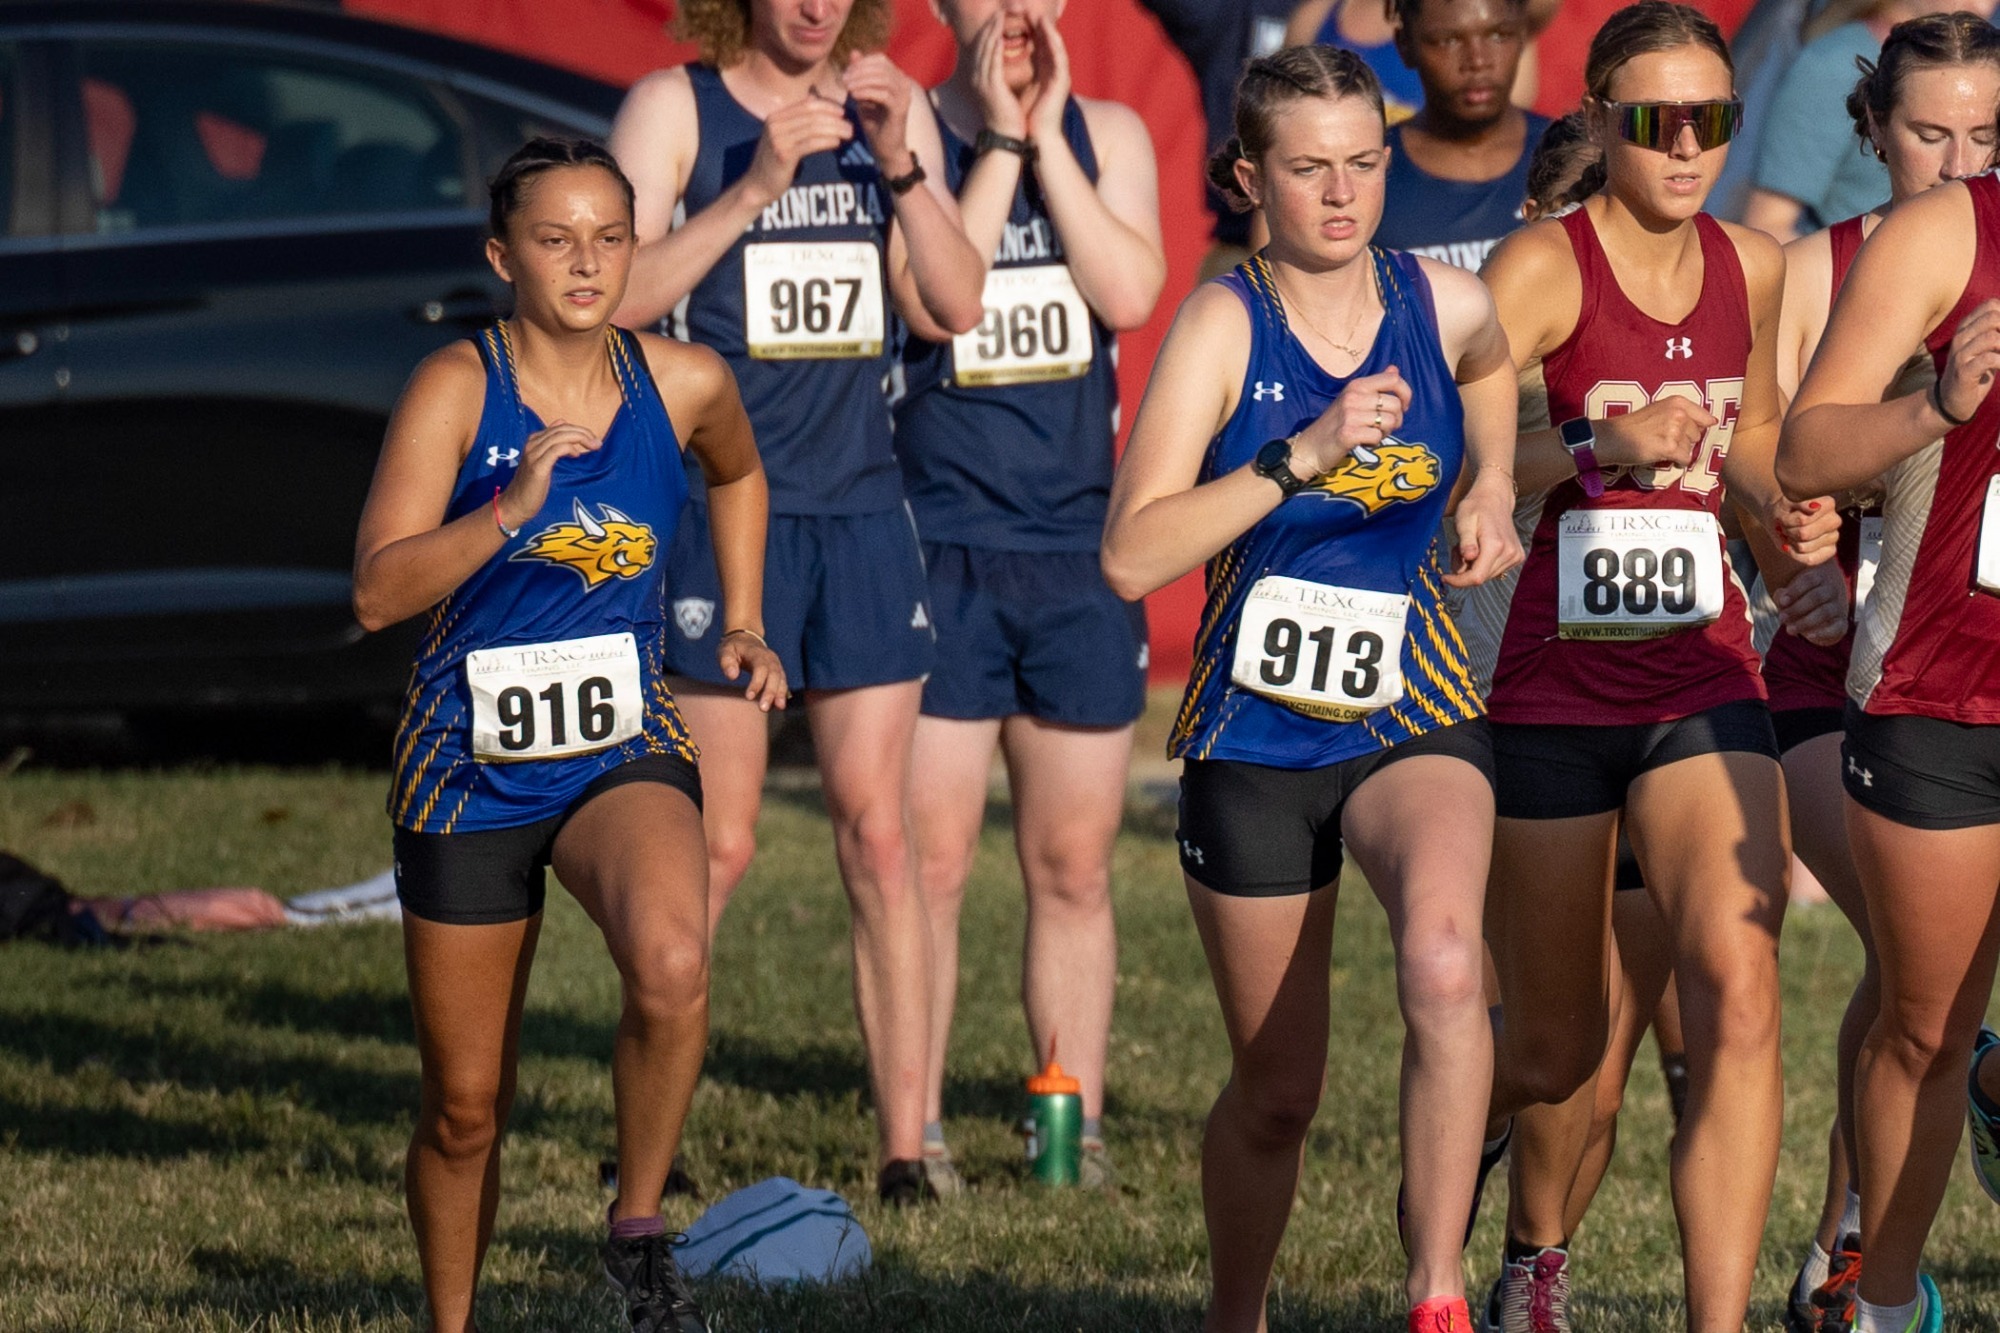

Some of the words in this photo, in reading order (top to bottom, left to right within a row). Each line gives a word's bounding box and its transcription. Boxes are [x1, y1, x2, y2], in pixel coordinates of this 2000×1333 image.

[744, 182, 885, 231] RINCIPIA
[770, 278, 862, 334] 967
[977, 301, 1069, 360] 960
[1604, 515, 1671, 530] TRXC
[1295, 586, 1365, 611] TRXC
[1583, 547, 1696, 615] 889
[514, 645, 586, 666] TRXC
[1260, 618, 1383, 698] 913
[497, 676, 614, 750] 916
